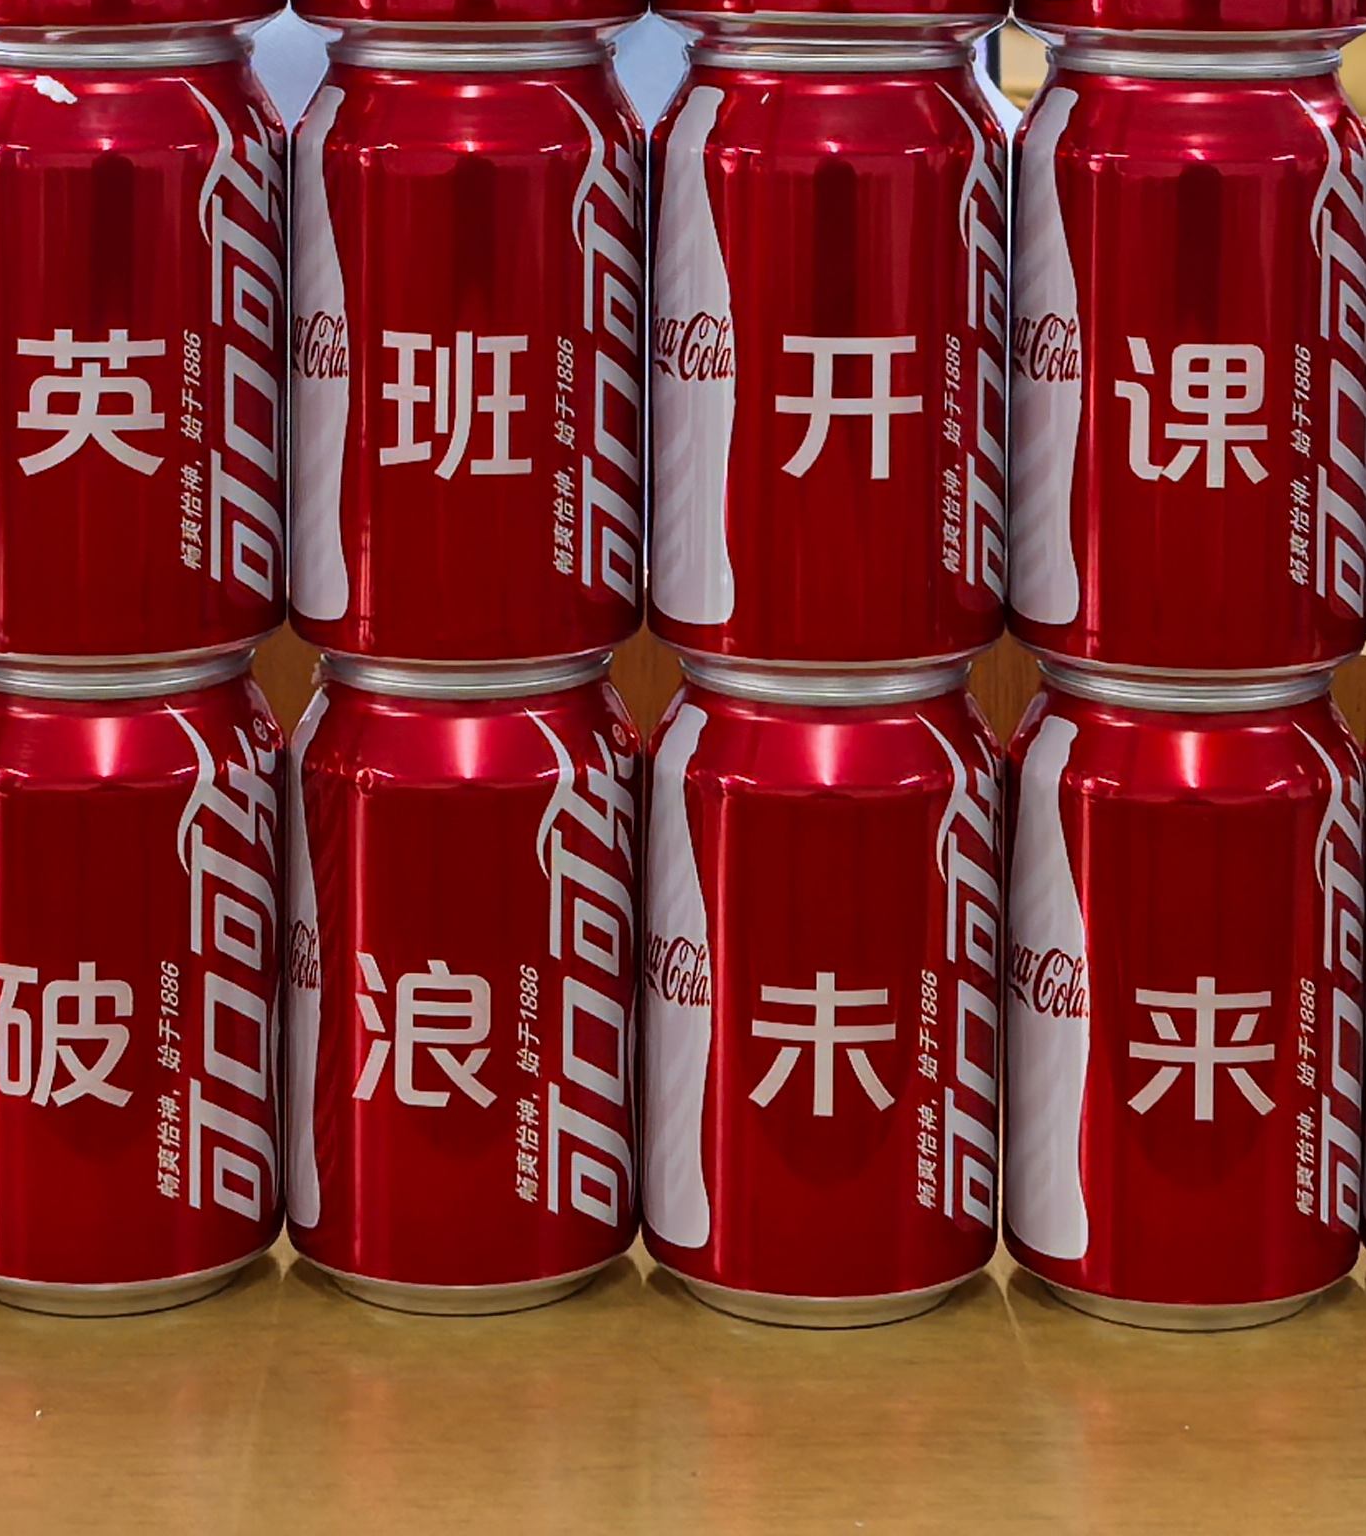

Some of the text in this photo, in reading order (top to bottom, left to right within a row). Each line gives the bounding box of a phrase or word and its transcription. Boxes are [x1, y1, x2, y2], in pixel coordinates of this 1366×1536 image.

[17, 328, 166, 476] 英
[379, 330, 532, 480] 班
[775, 334, 923, 480] 开
[1114, 336, 1269, 488] 课
[352, 950, 497, 1108] 浪
[748, 971, 896, 1117] 未
[1127, 976, 1276, 1121] 来
